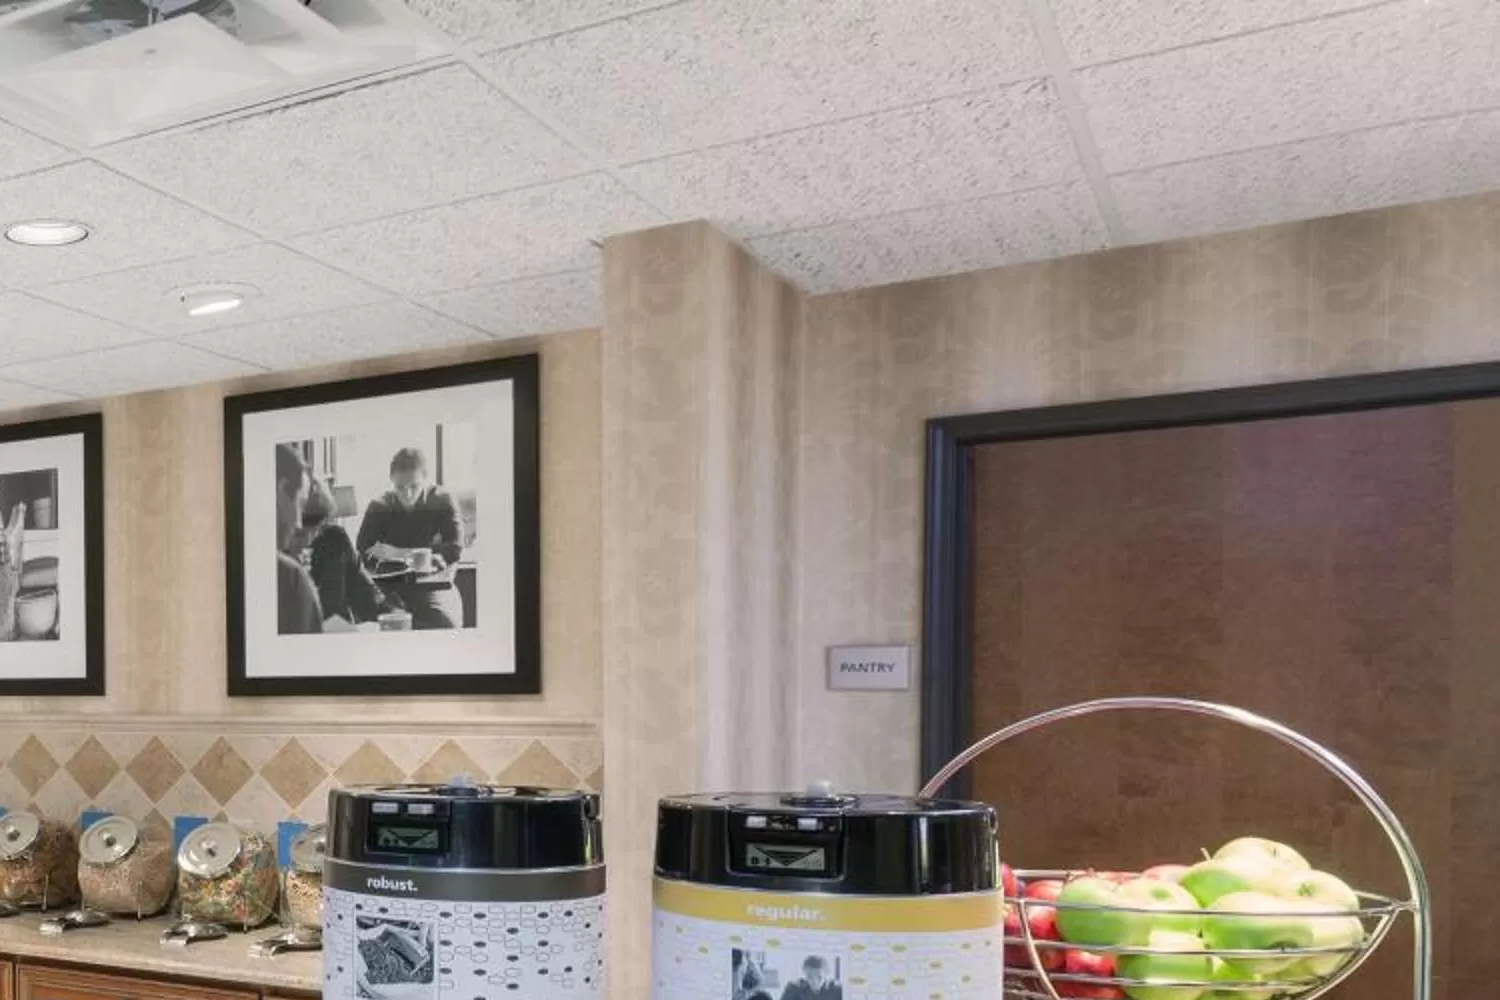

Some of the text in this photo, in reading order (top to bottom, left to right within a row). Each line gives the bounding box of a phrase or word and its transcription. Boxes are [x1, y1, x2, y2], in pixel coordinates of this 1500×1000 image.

[840, 661, 897, 673] PANTRY
[366, 876, 419, 892] robust.
[747, 903, 826, 922] regular.
